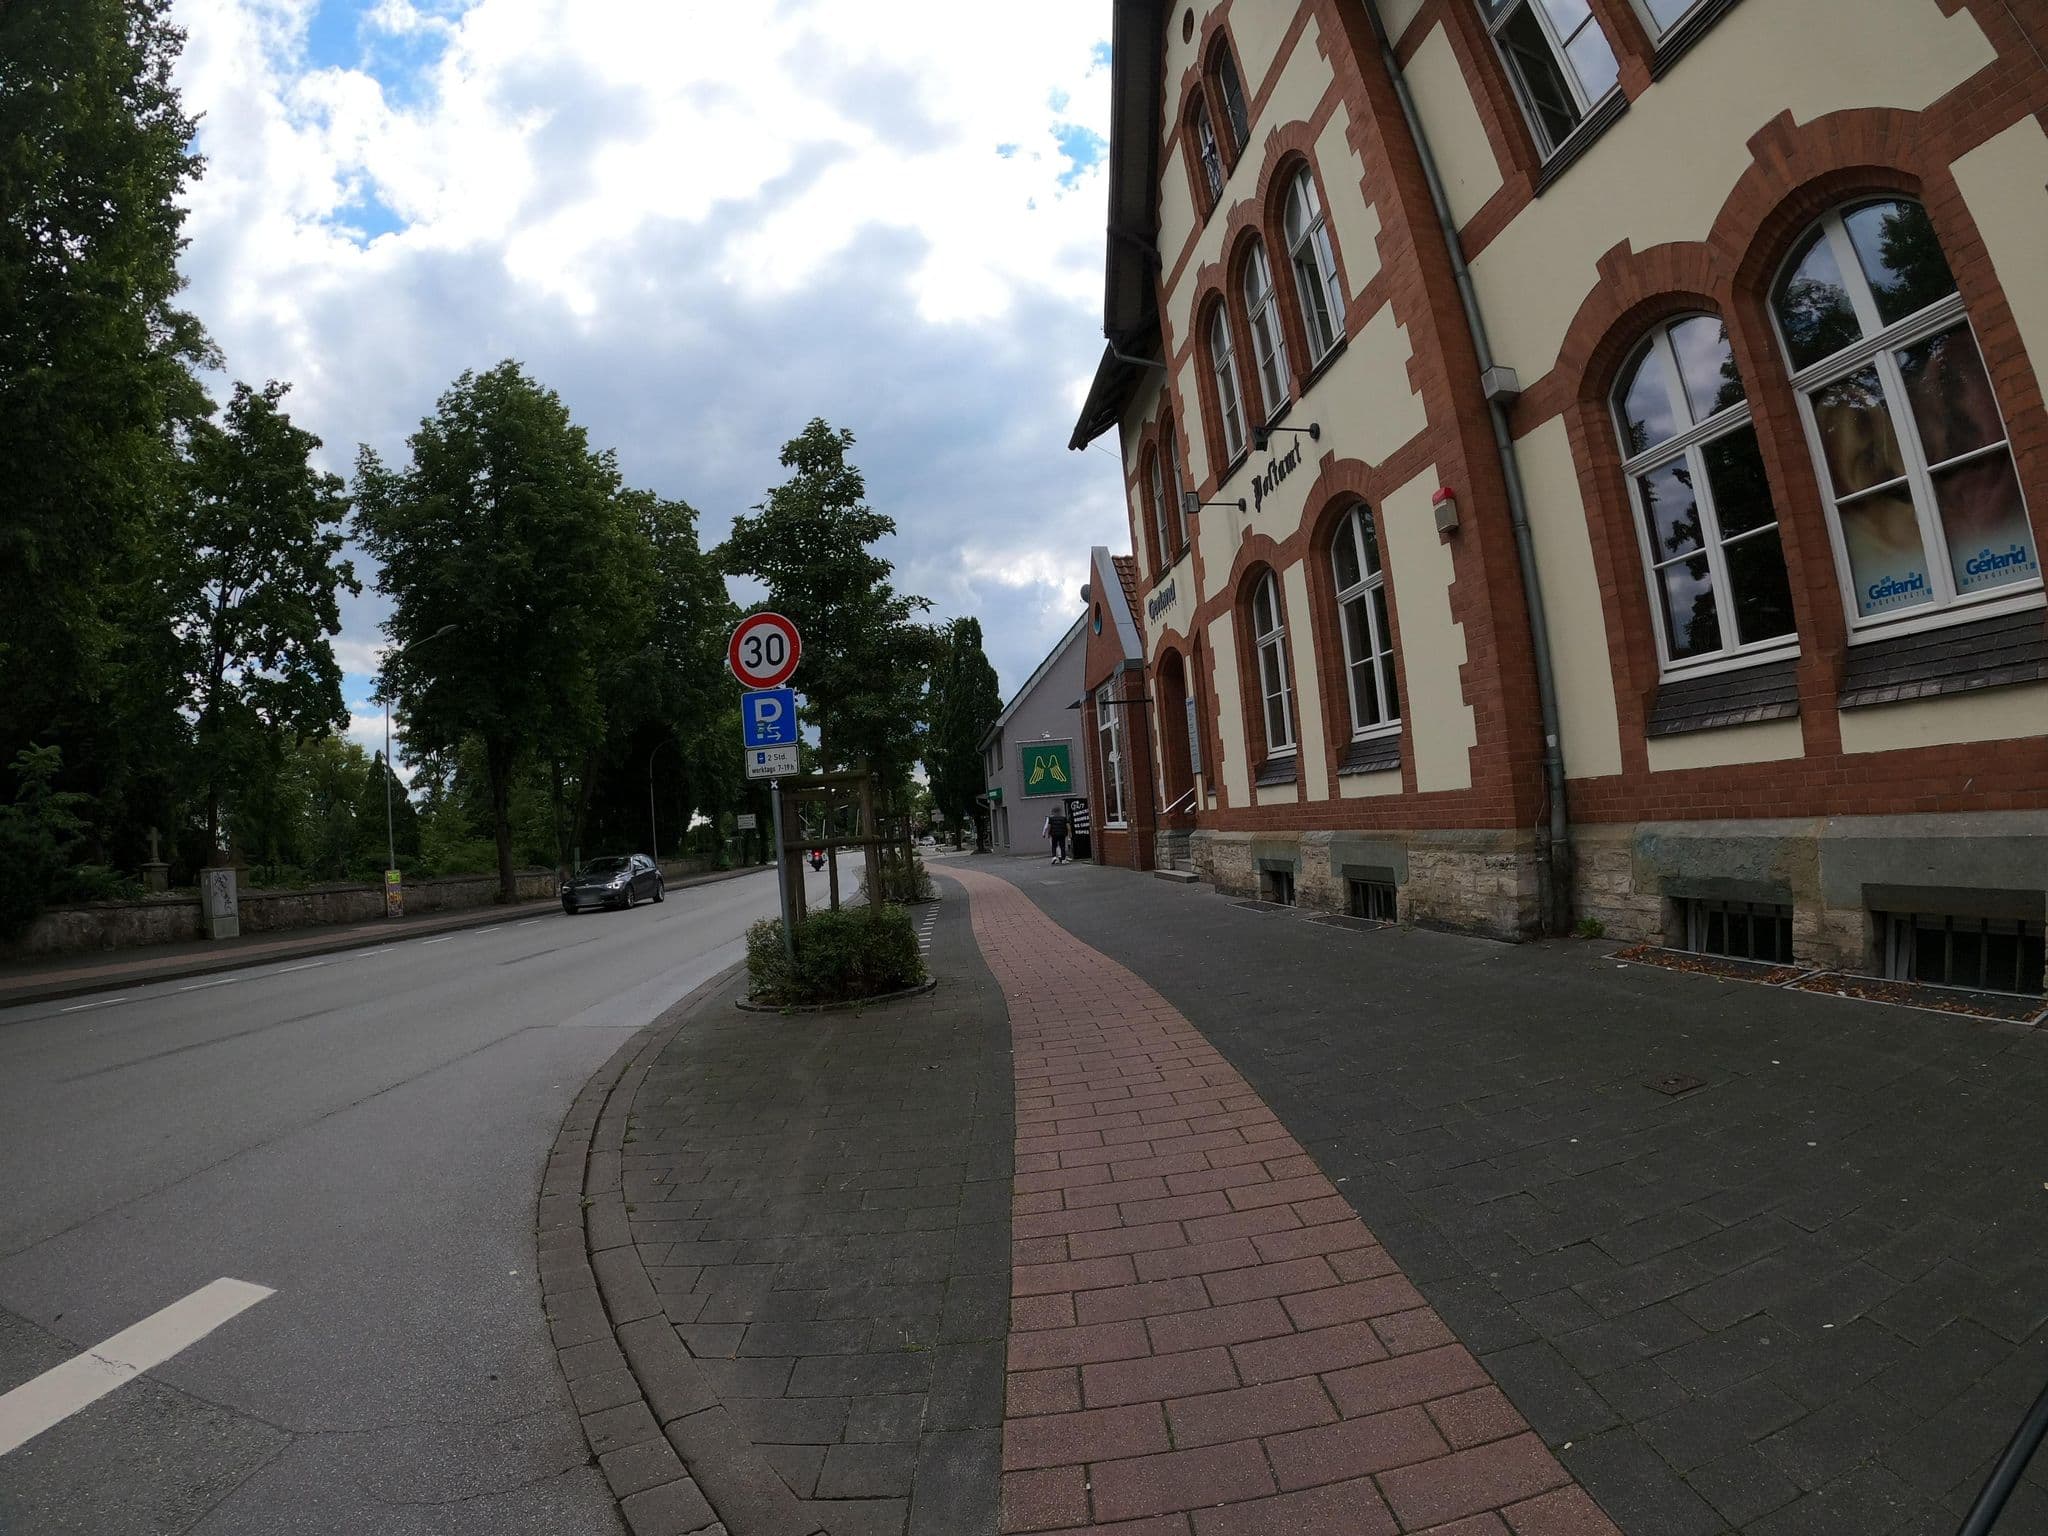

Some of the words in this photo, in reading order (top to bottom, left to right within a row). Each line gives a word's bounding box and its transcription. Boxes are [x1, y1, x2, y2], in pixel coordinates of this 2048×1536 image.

[1966, 546, 2027, 575] Gerland
[1868, 573, 1924, 600] Gerland
[744, 633, 784, 668] 30
[751, 766, 776, 774] werktags
[777, 764, 790, 772] 7-19
[767, 754, 772, 762] 2
[773, 753, 788, 761] Std.
